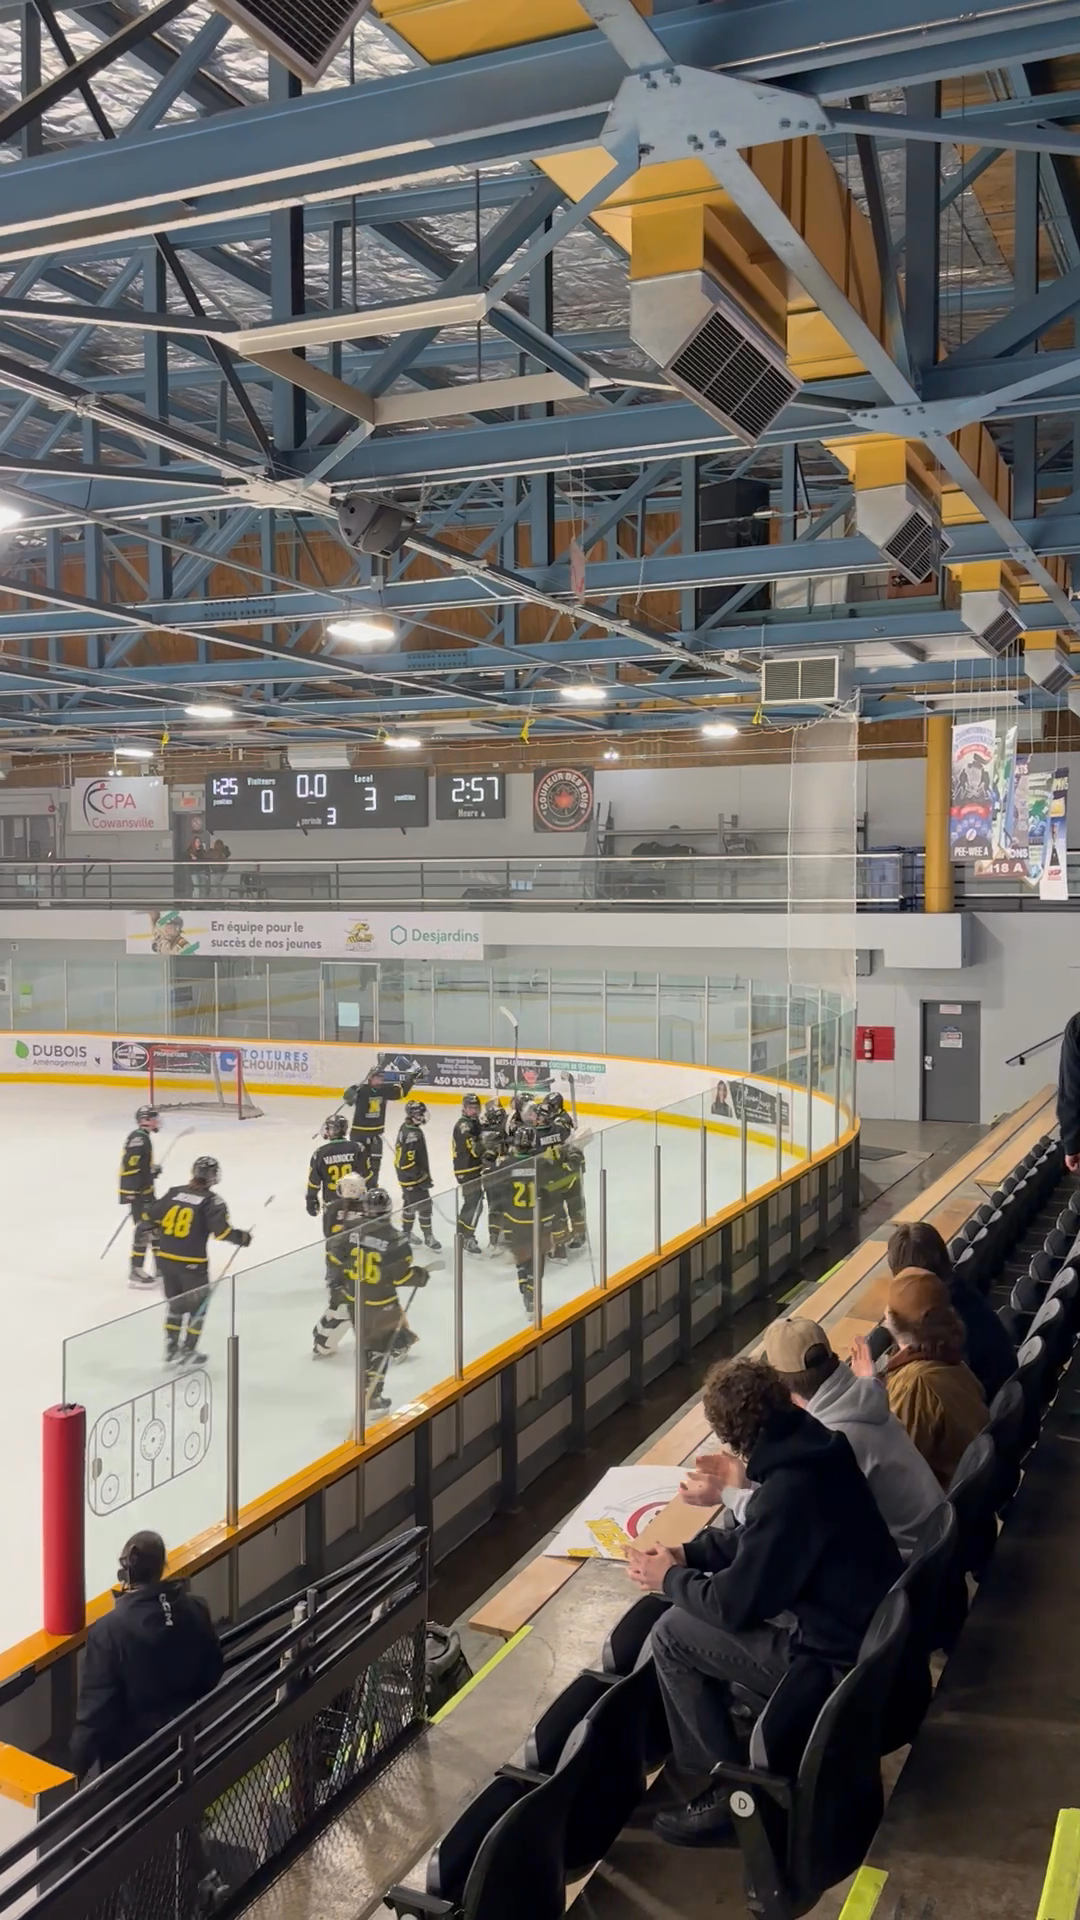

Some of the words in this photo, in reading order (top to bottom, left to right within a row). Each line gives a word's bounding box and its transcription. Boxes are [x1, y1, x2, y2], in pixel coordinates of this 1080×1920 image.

[297, 774, 327, 798] 0.0
[354, 774, 373, 783] Local
[213, 778, 238, 795] 1:25
[452, 777, 499, 802] 2:57
[540, 773, 563, 810] COUREUR
[565, 773, 581, 786] DES
[579, 785, 588, 809] BOIS
[101, 793, 137, 810] CPA
[261, 790, 273, 813] 0
[364, 787, 377, 811] 3
[92, 817, 154, 829] Cowansville
[327, 807, 337, 825] 3
[954, 847, 982, 857] PEE-WEE
[983, 847, 988, 856] A
[1013, 862, 1023, 872] A
[211, 921, 224, 932] En
[227, 921, 264, 935] équipe
[266, 924, 292, 936] pour
[294, 922, 304, 932] le
[412, 928, 479, 944] Desjardins
[211, 937, 246, 948] succès
[248, 937, 262, 948] de
[264, 940, 284, 949] nos
[285, 938, 322, 951] jeunes
[32, 1044, 87, 1058] DUBOIS
[242, 1049, 309, 1062] TOITURES
[32, 1058, 87, 1067] Aménagement
[242, 1060, 309, 1072] CHOUINARD
[434, 1076, 450, 1086] 450
[452, 1077, 489, 1087] 931-0225
[161, 1205, 194, 1239] 48
[348, 1247, 382, 1284] 36
[738, 1797, 747, 1810] D
